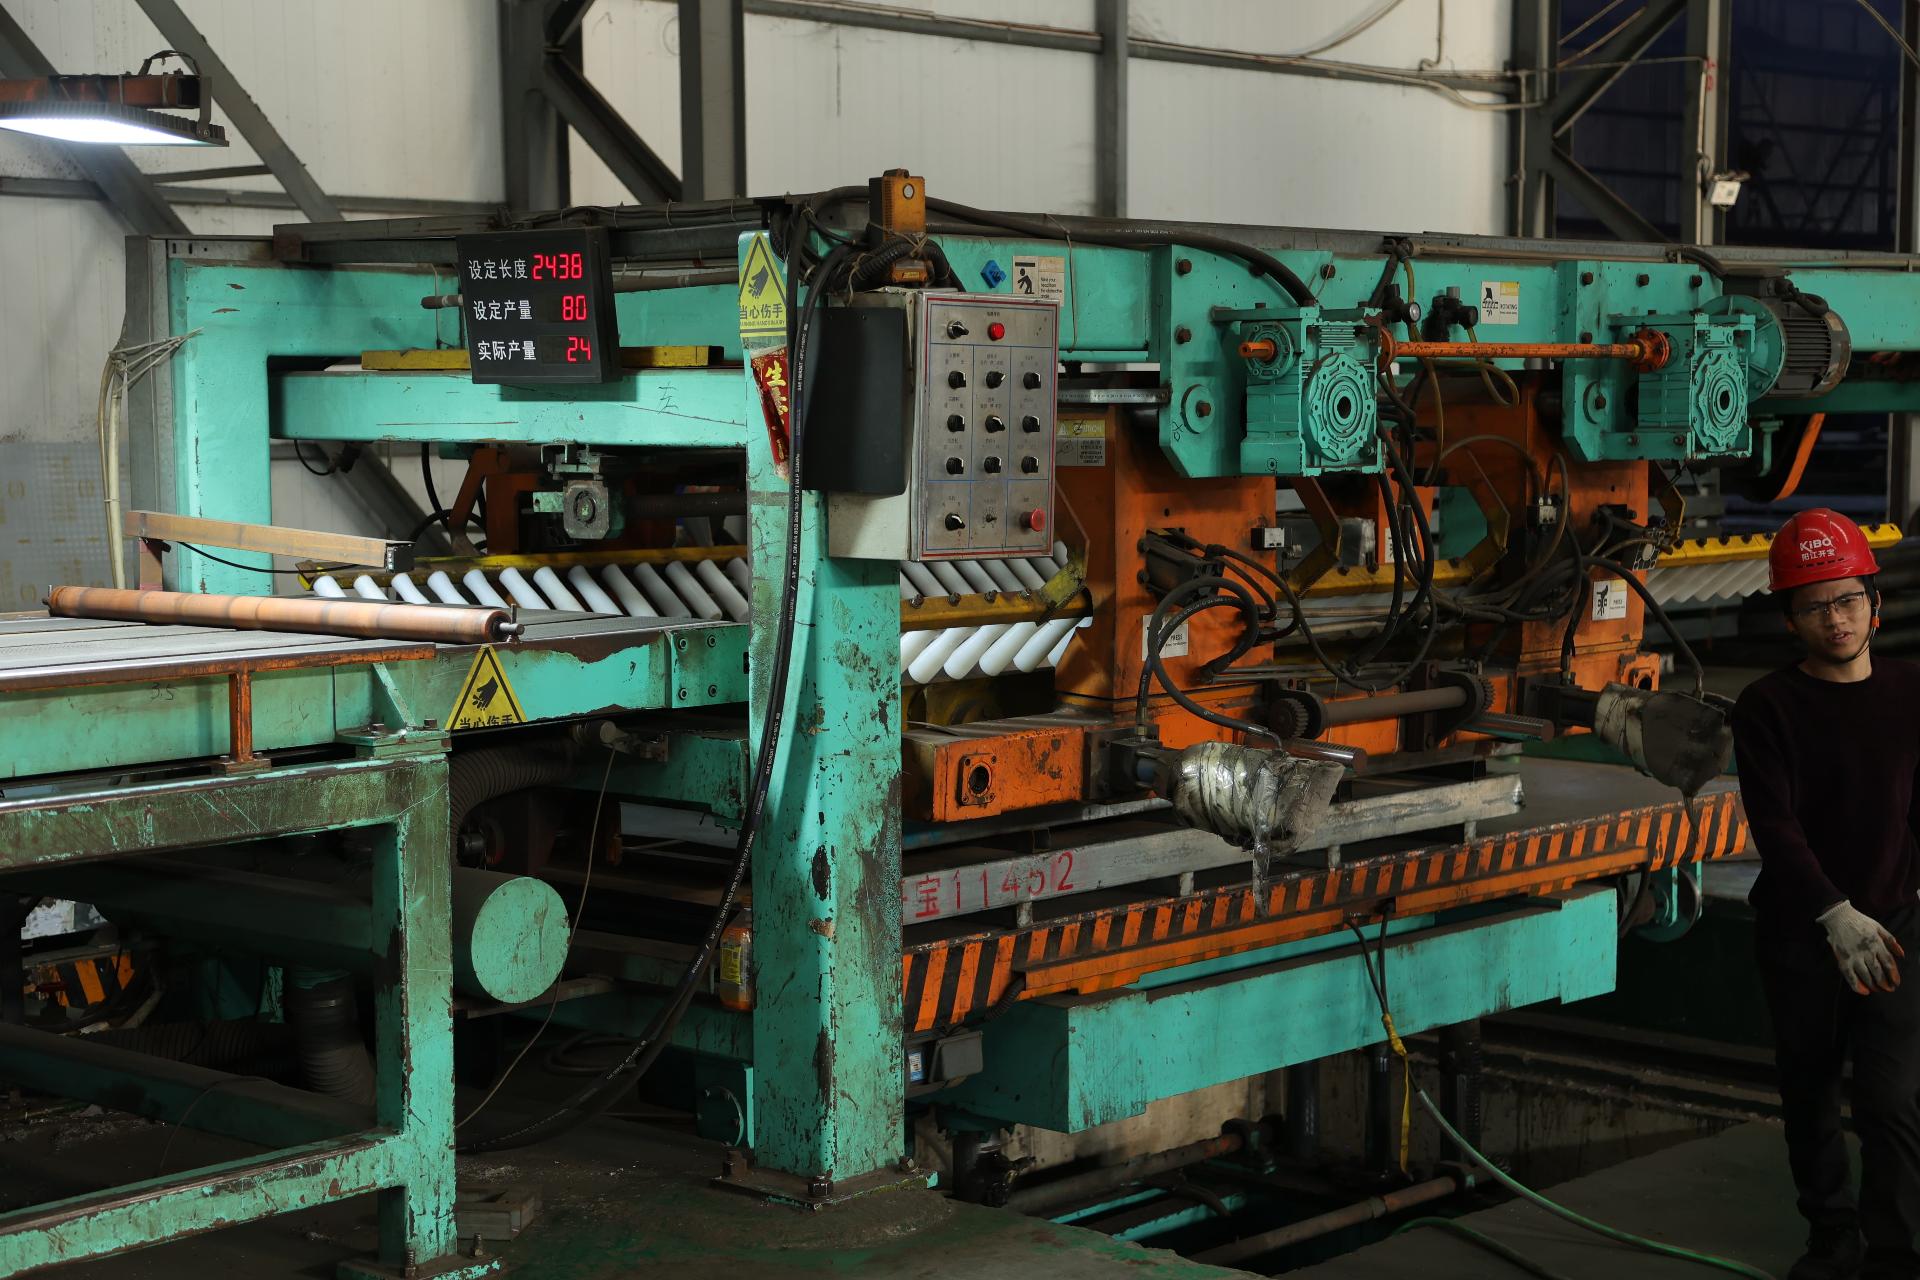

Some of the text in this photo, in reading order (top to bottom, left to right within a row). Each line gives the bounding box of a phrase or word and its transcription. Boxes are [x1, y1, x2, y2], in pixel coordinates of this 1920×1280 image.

[468, 253, 583, 280] 设定长度 2438
[473, 295, 588, 321] 设定产量 80
[740, 303, 783, 320] 当心伤手
[477, 336, 592, 362] 实际产量 24
